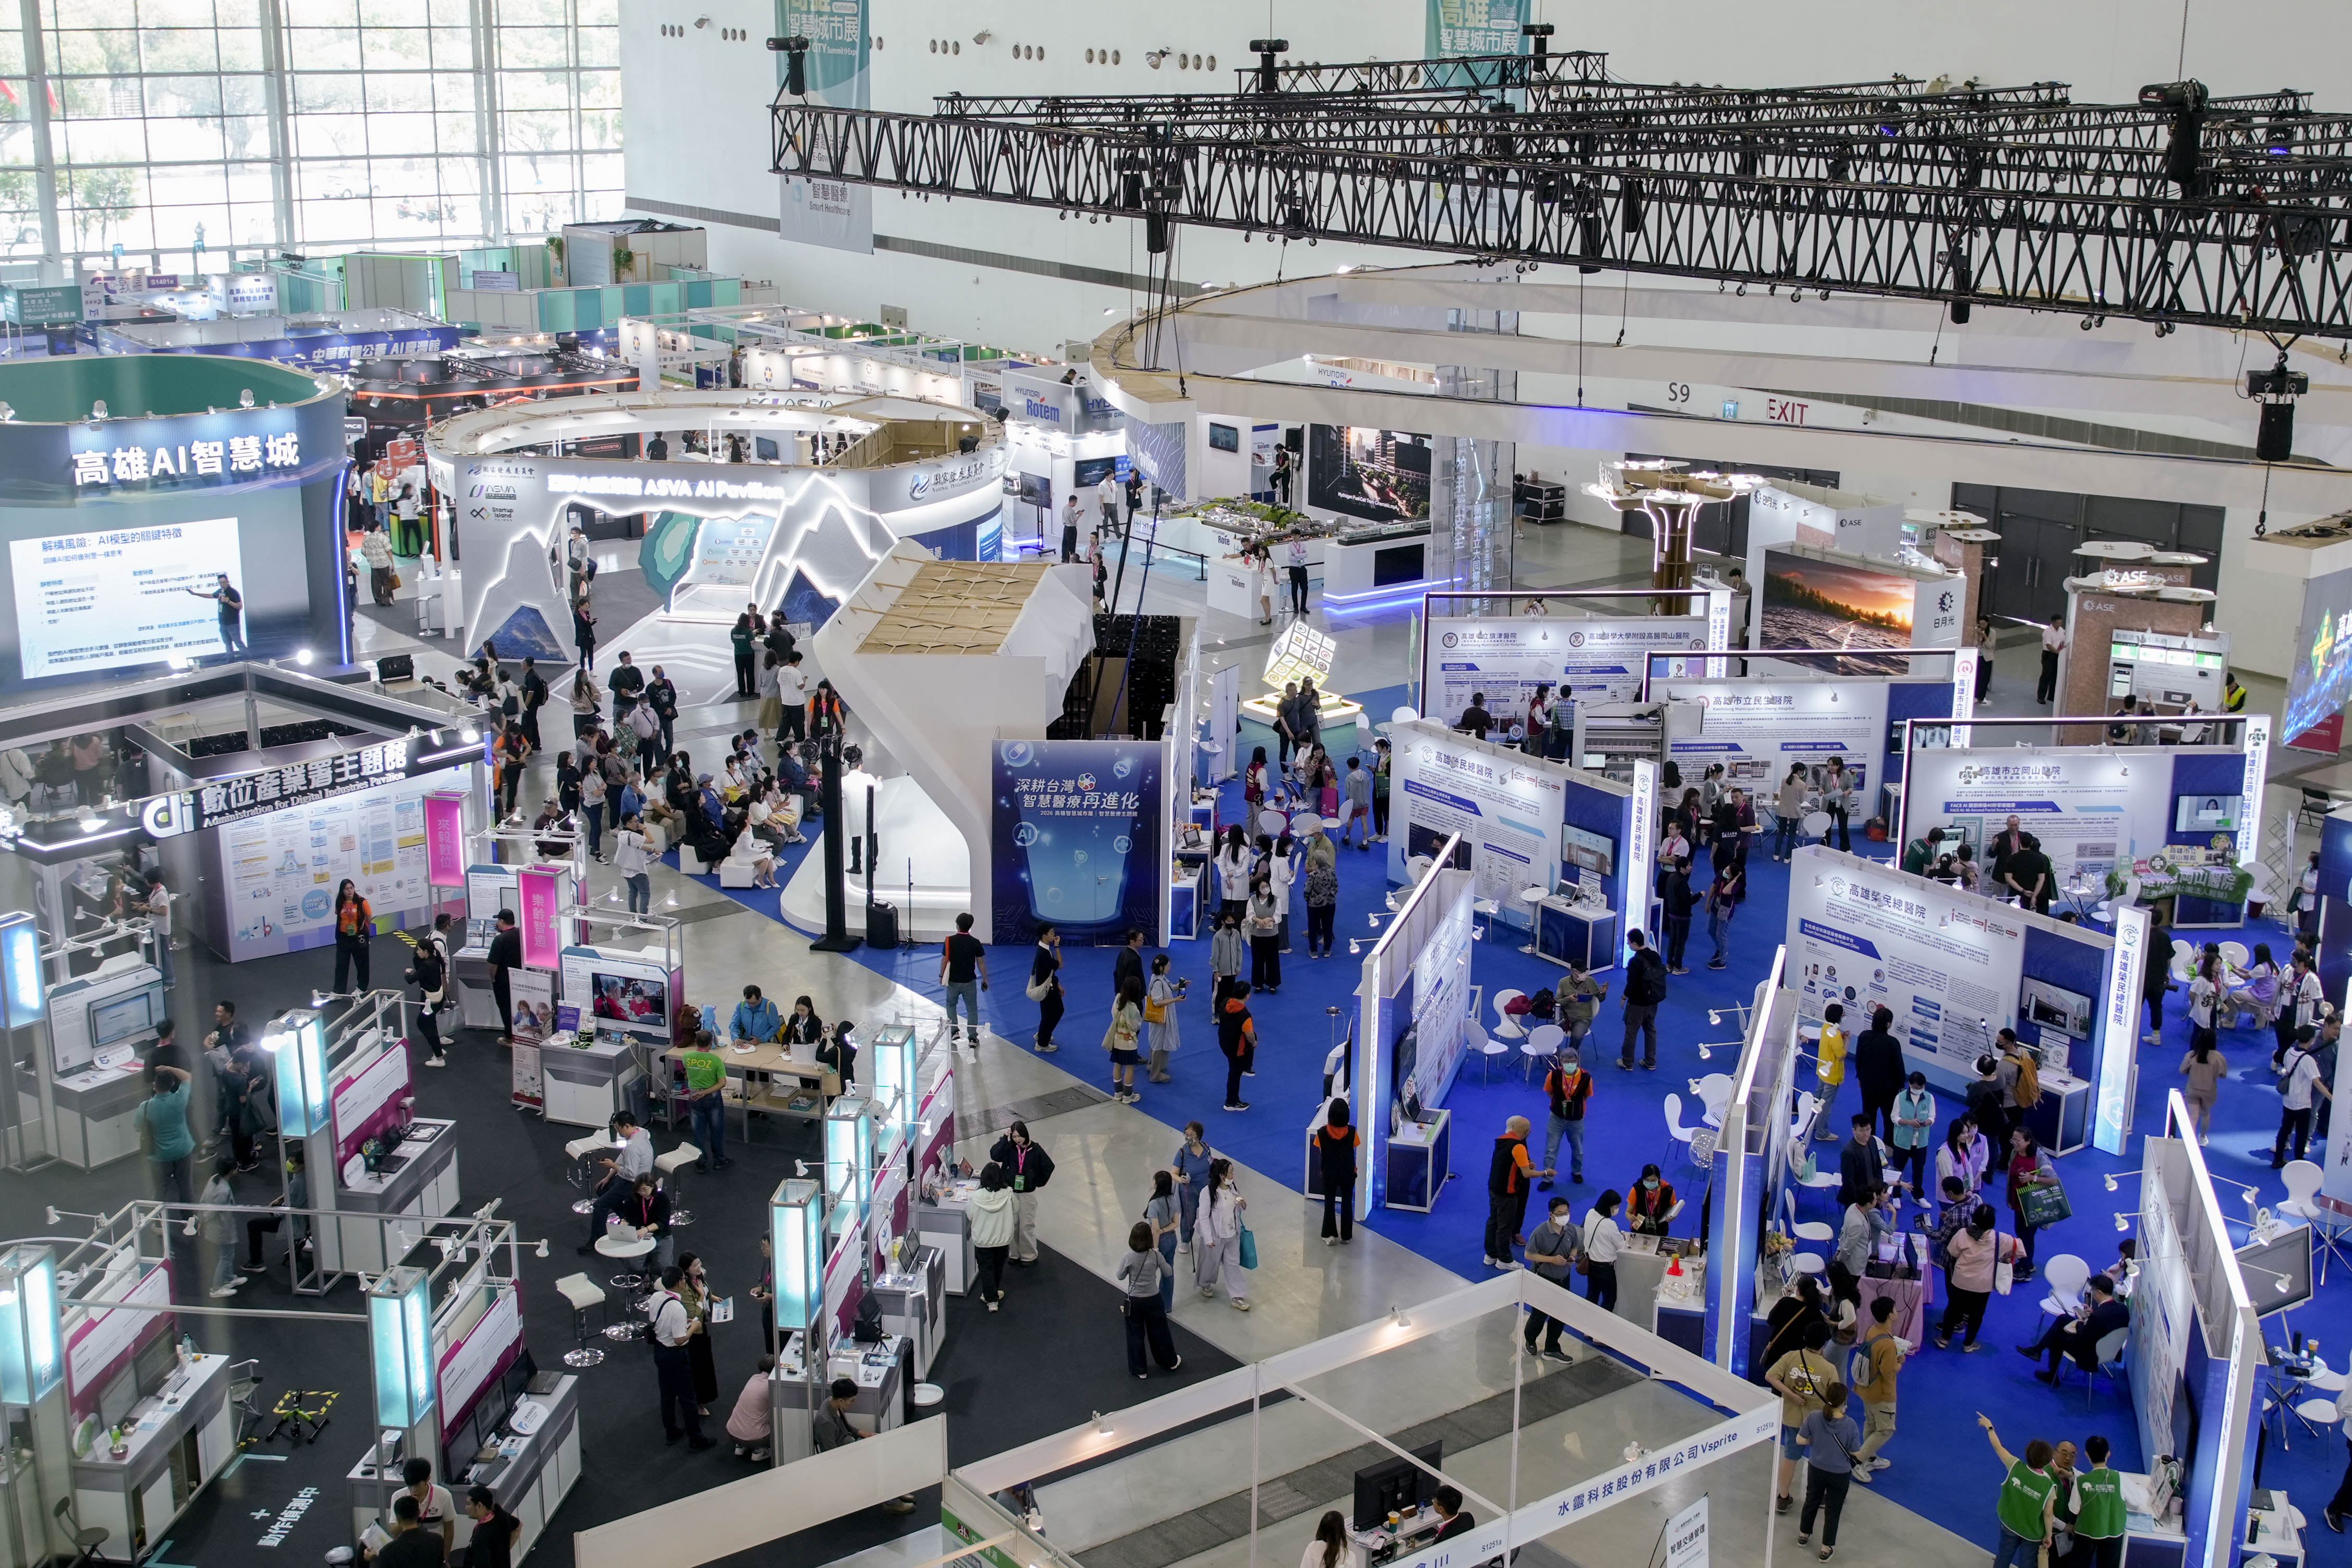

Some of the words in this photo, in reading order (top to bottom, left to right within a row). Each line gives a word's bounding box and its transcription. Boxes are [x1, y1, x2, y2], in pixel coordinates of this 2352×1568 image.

[790, 13, 859, 42] 智慧城市展
[812, 42, 826, 53] CITY
[1440, 28, 1518, 54] 智慧城市展
[812, 183, 848, 203] 智慧醫療
[810, 201, 823, 211] Smart
[825, 203, 850, 216] Healthcare
[1318, 368, 1346, 379] HYUNDAI
[1015, 387, 1040, 399] HYUNDAI
[1669, 382, 1690, 402] S9
[1027, 399, 1059, 423] Rotem
[1767, 398, 1808, 425] EXIT
[72, 432, 300, 487] 高雄AI智慧城
[483, 466, 535, 475] 國家發展委員會
[933, 462, 984, 485] 國家發展委員會
[644, 479, 692, 497] ASVA
[695, 480, 714, 497] AI
[716, 481, 785, 499] Pavilion
[1763, 494, 1777, 510] 日月光
[1232, 579, 1245, 588] Rotem
[2119, 570, 2148, 583] ASE
[1934, 616, 1955, 629] 日月光
[1953, 680, 1965, 742] 高雄市立民醫院
[201, 741, 407, 815] 數位產業署主題館
[1015, 778, 1075, 793] 深耕台灣
[203, 804, 274, 828] Administration
[274, 798, 289, 810] for
[290, 792, 323, 806] Digital
[324, 781, 368, 798] Industries
[369, 771, 405, 788] Pavilion
[1023, 792, 1139, 810] 智慧醫療再進化
[438, 818, 452, 868] 來毅數位
[1018, 829, 1032, 839] AI
[1849, 897, 1869, 908] Kaohsiung
[1871, 904, 1889, 914] Veterans
[1890, 910, 1906, 919] General
[1907, 914, 1925, 926] Hospital
[1850, 884, 1926, 919] 高雄榮民總醫院
[532, 894, 547, 947] 樂齡智造
[2113, 950, 2129, 1026] 高雄榮民總醫院
[686, 1058, 713, 1069] SPOZ
[1756, 1421, 1774, 1435] S1251a
[1558, 1444, 1699, 1517] 水靈科技股份有限公司
[1701, 1431, 1739, 1455] Vsprite
[257, 1487, 320, 1548] 動作偵測中
[1481, 1539, 1502, 1552] S1251a
[1671, 1523, 1705, 1554] 智慧交通管理
